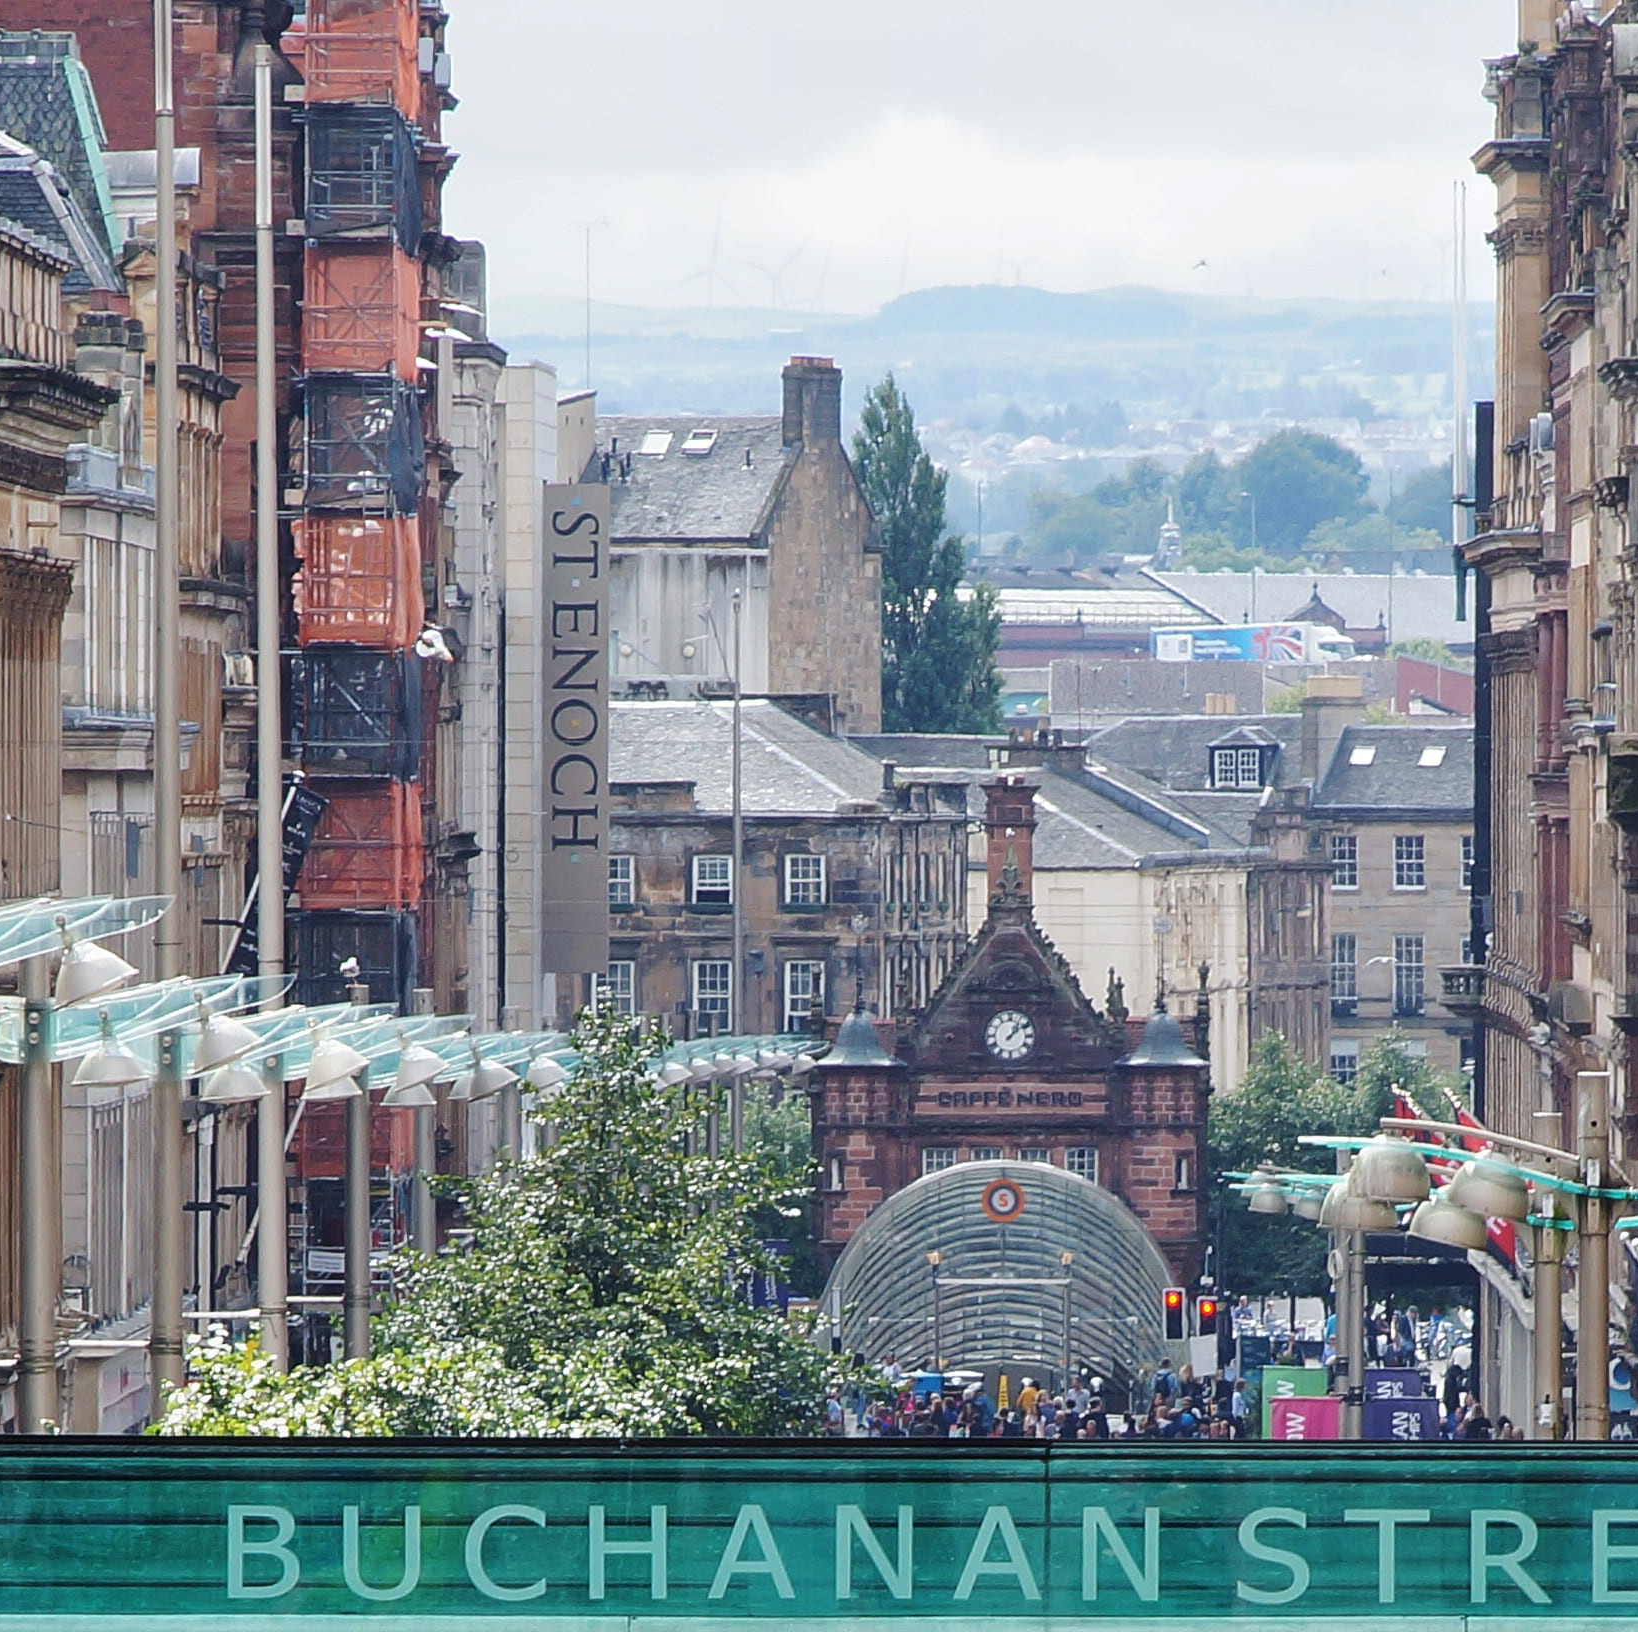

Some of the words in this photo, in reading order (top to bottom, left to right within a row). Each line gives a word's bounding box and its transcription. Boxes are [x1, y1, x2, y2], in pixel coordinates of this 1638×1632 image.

[552, 511, 600, 578] ST
[550, 600, 600, 851] ENOCH
[1017, 1091, 1083, 1108] NERO
[226, 1504, 1159, 1602] BUCHANAN
